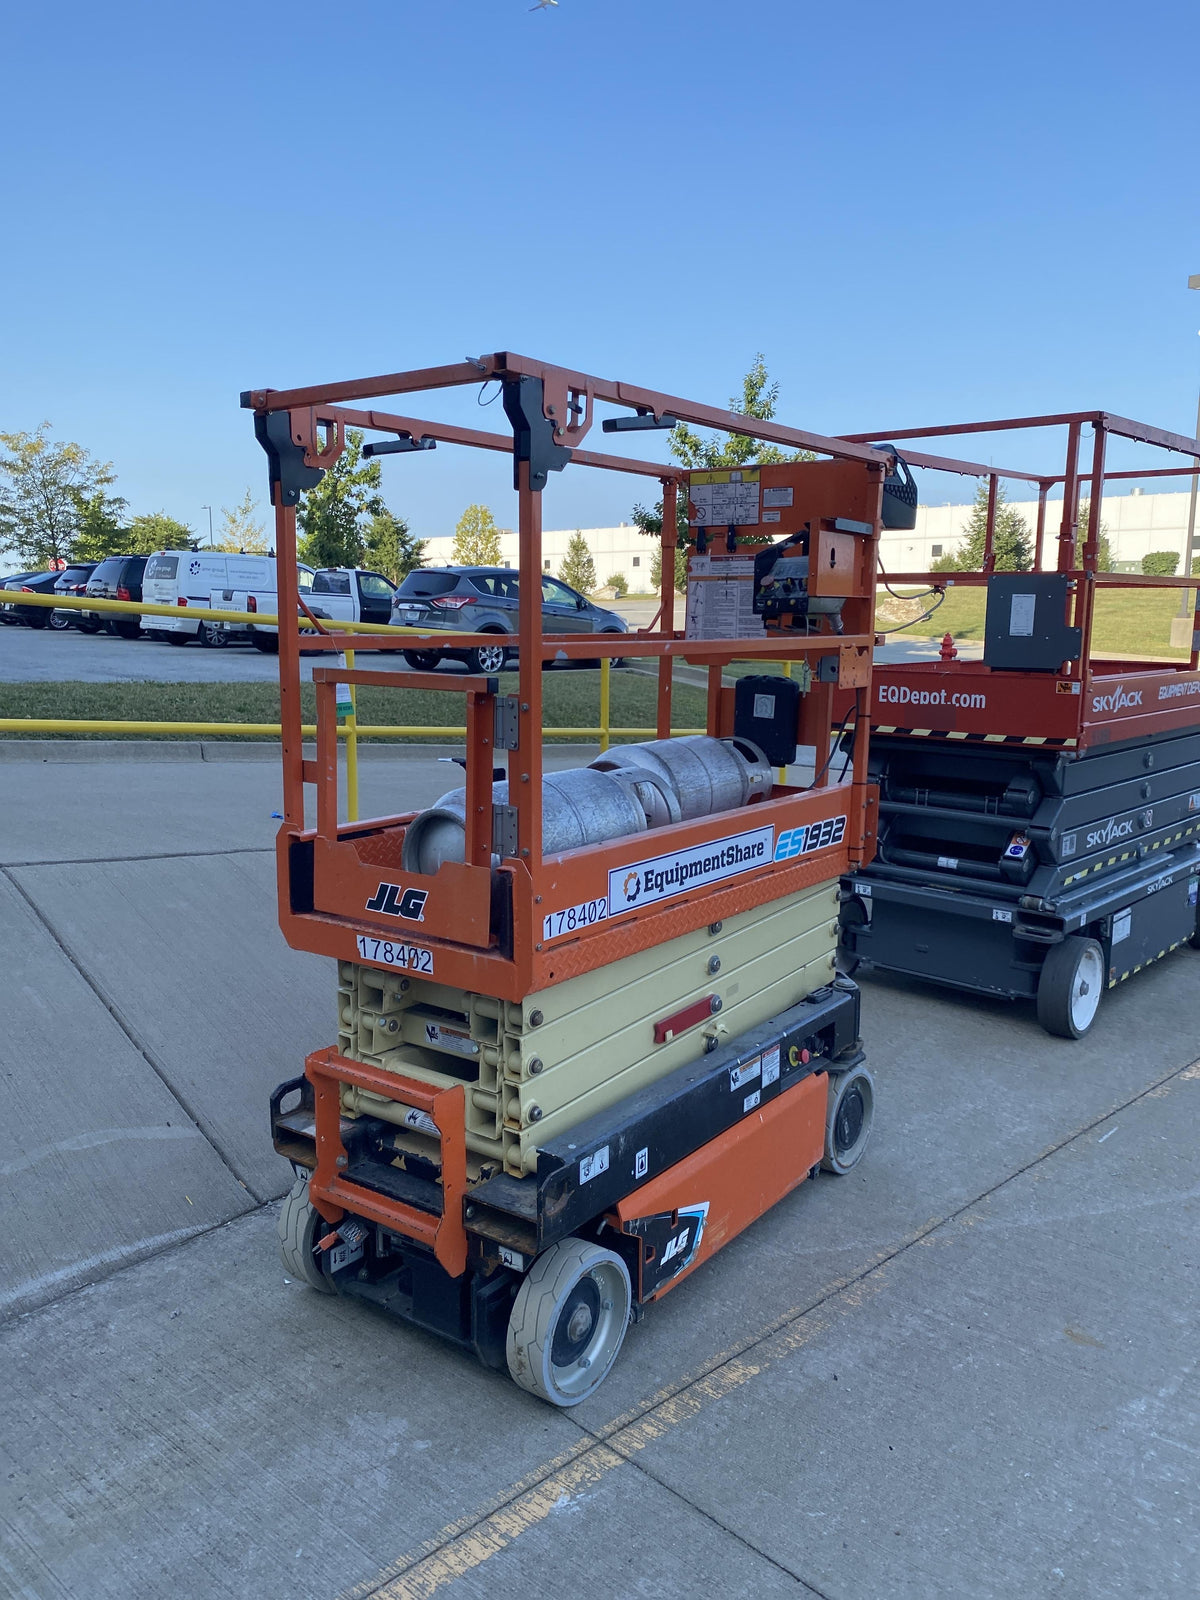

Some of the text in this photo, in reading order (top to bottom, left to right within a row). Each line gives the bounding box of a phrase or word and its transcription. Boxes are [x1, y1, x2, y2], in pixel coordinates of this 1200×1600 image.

[1092, 685, 1143, 713] SKYJACK
[775, 816, 846, 861] ES1932
[1086, 818, 1134, 848] SKYJACK
[643, 840, 764, 893] EquipmentShare
[1147, 875, 1173, 894] SKYJACK
[366, 882, 428, 921] JLG
[545, 898, 608, 938] 178402
[359, 937, 432, 973] 178402
[660, 1227, 690, 1266] JLG
